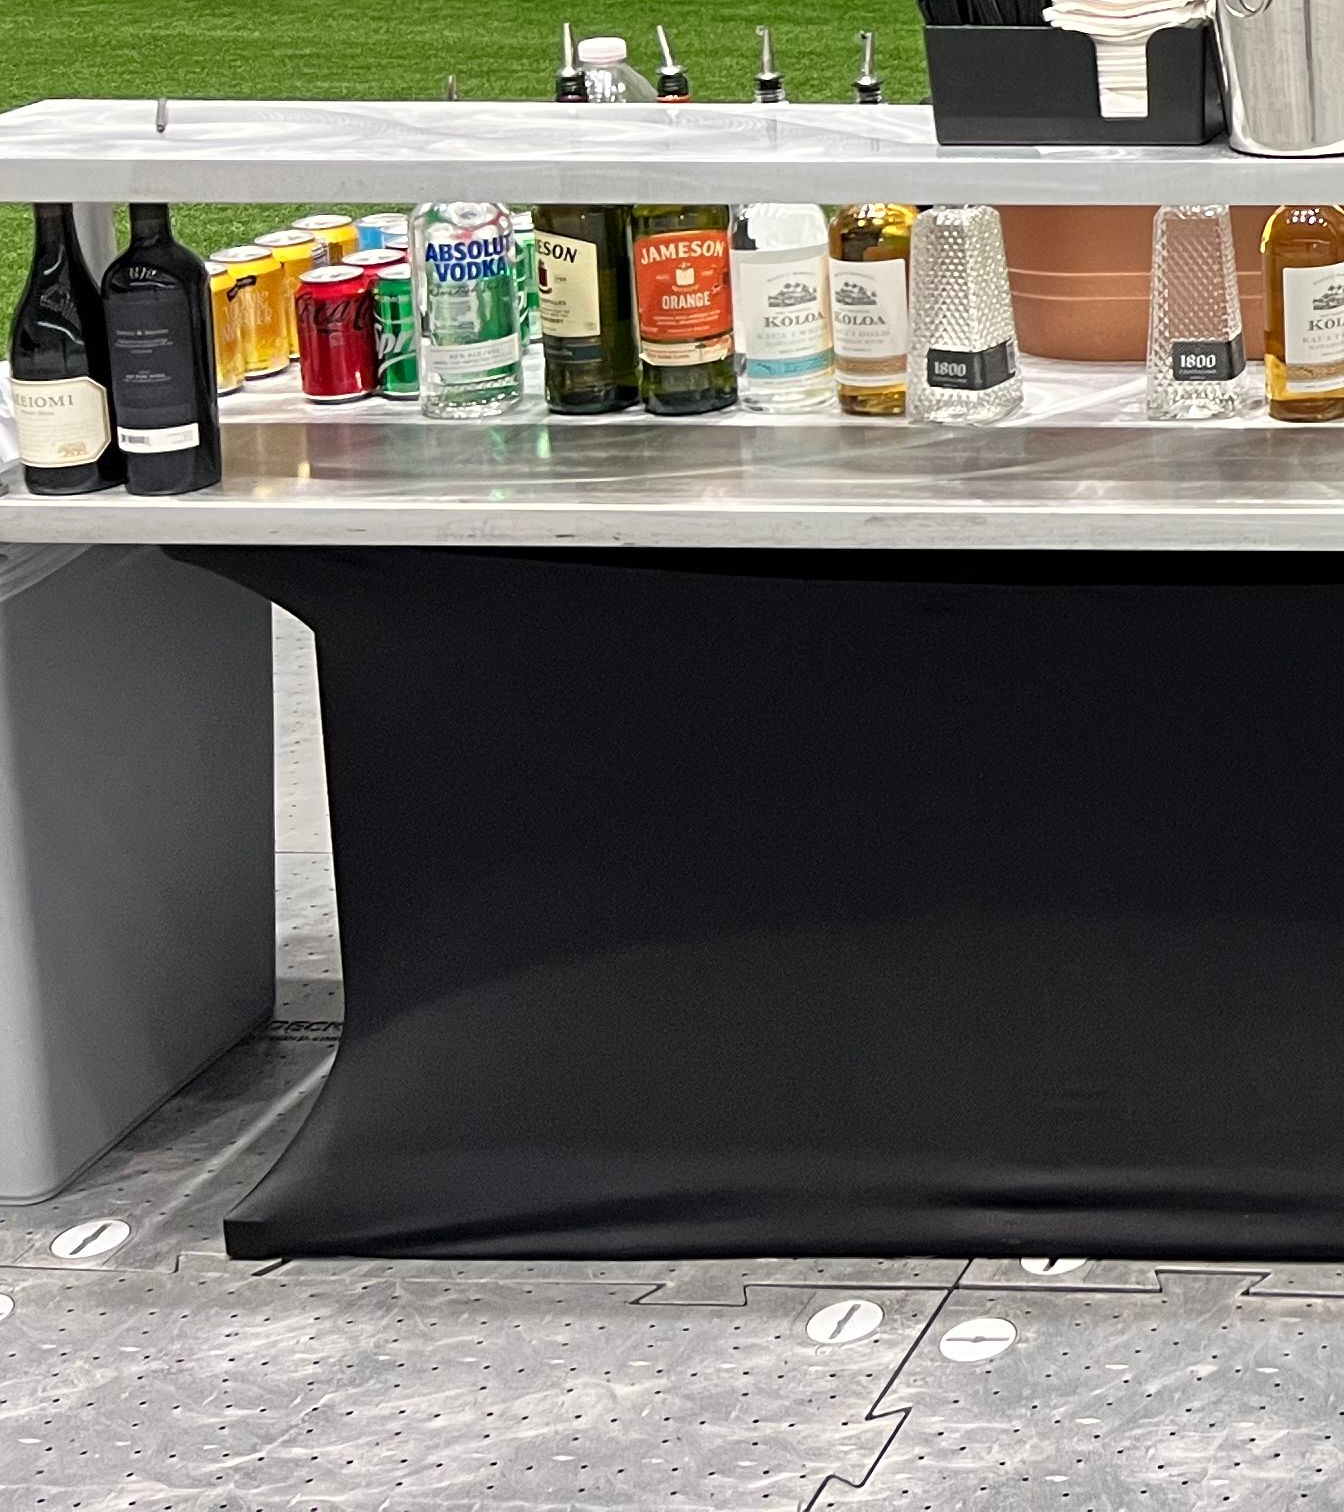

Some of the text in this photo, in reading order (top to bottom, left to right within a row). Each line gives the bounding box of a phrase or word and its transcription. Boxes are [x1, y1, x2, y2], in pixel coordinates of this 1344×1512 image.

[425, 234, 511, 263] ABSOLUT
[640, 239, 725, 265] JAMESON
[435, 256, 508, 282] VODKA
[661, 290, 711, 310] ORANGE
[763, 311, 826, 328] KOLOA
[834, 314, 886, 326] KOLOA
[933, 360, 967, 378] 1800
[1179, 354, 1217, 369] 1800
